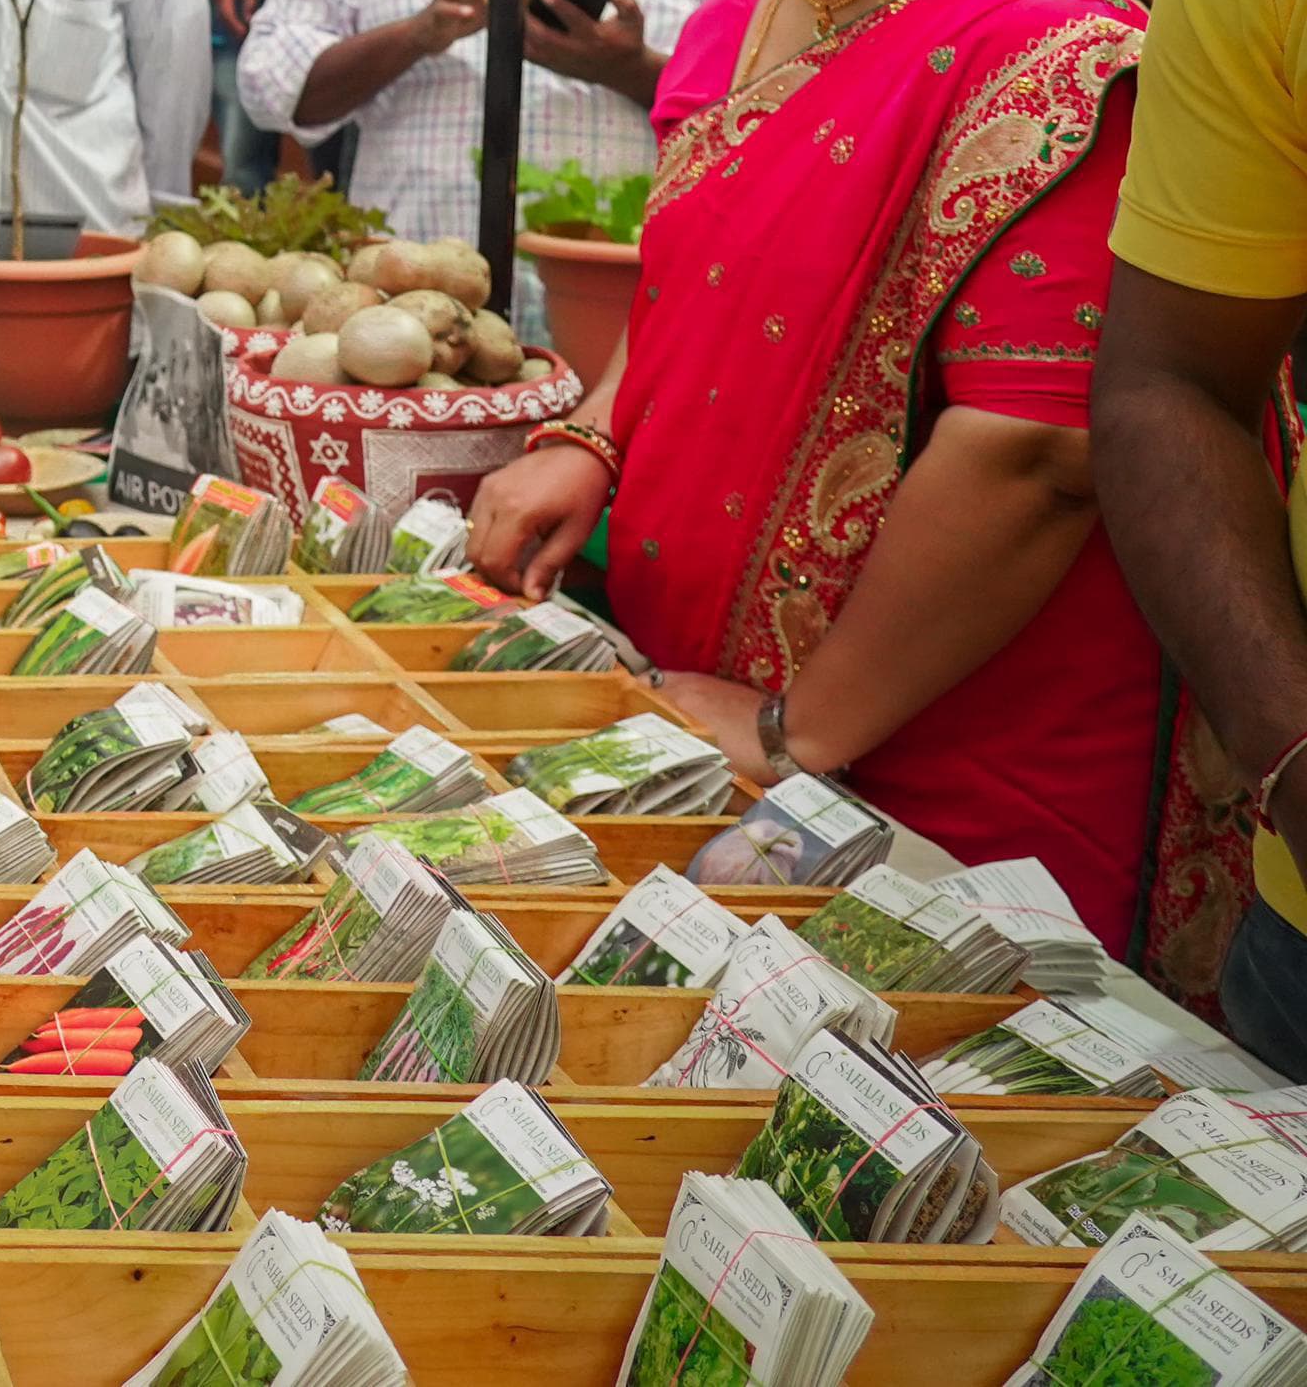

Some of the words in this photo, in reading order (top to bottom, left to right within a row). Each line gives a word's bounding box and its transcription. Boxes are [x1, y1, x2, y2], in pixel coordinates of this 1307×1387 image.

[114, 469, 146, 503] AIR
[164, 985, 191, 1014] SEEDS
[783, 983, 812, 1013] SEEDS
[1041, 1015, 1090, 1051] SAHJA
[1089, 1042, 1129, 1068] SEEDS
[835, 1060, 886, 1108] SAHAJA
[169, 1115, 195, 1146] SEED
[507, 1105, 548, 1148] SAHAJA
[1196, 1120, 1247, 1161] SAHJA
[1244, 1159, 1286, 1187] SEEDS
[1082, 1218, 1107, 1242] Soppu
[700, 1229, 740, 1275] SAHAA
[739, 1267, 774, 1307] SEEDS
[265, 1257, 291, 1299] SAHAA
[288, 1291, 317, 1333] SEEDS
[1156, 1265, 1209, 1306] SAHJA
[1204, 1299, 1256, 1340] SEEDS
